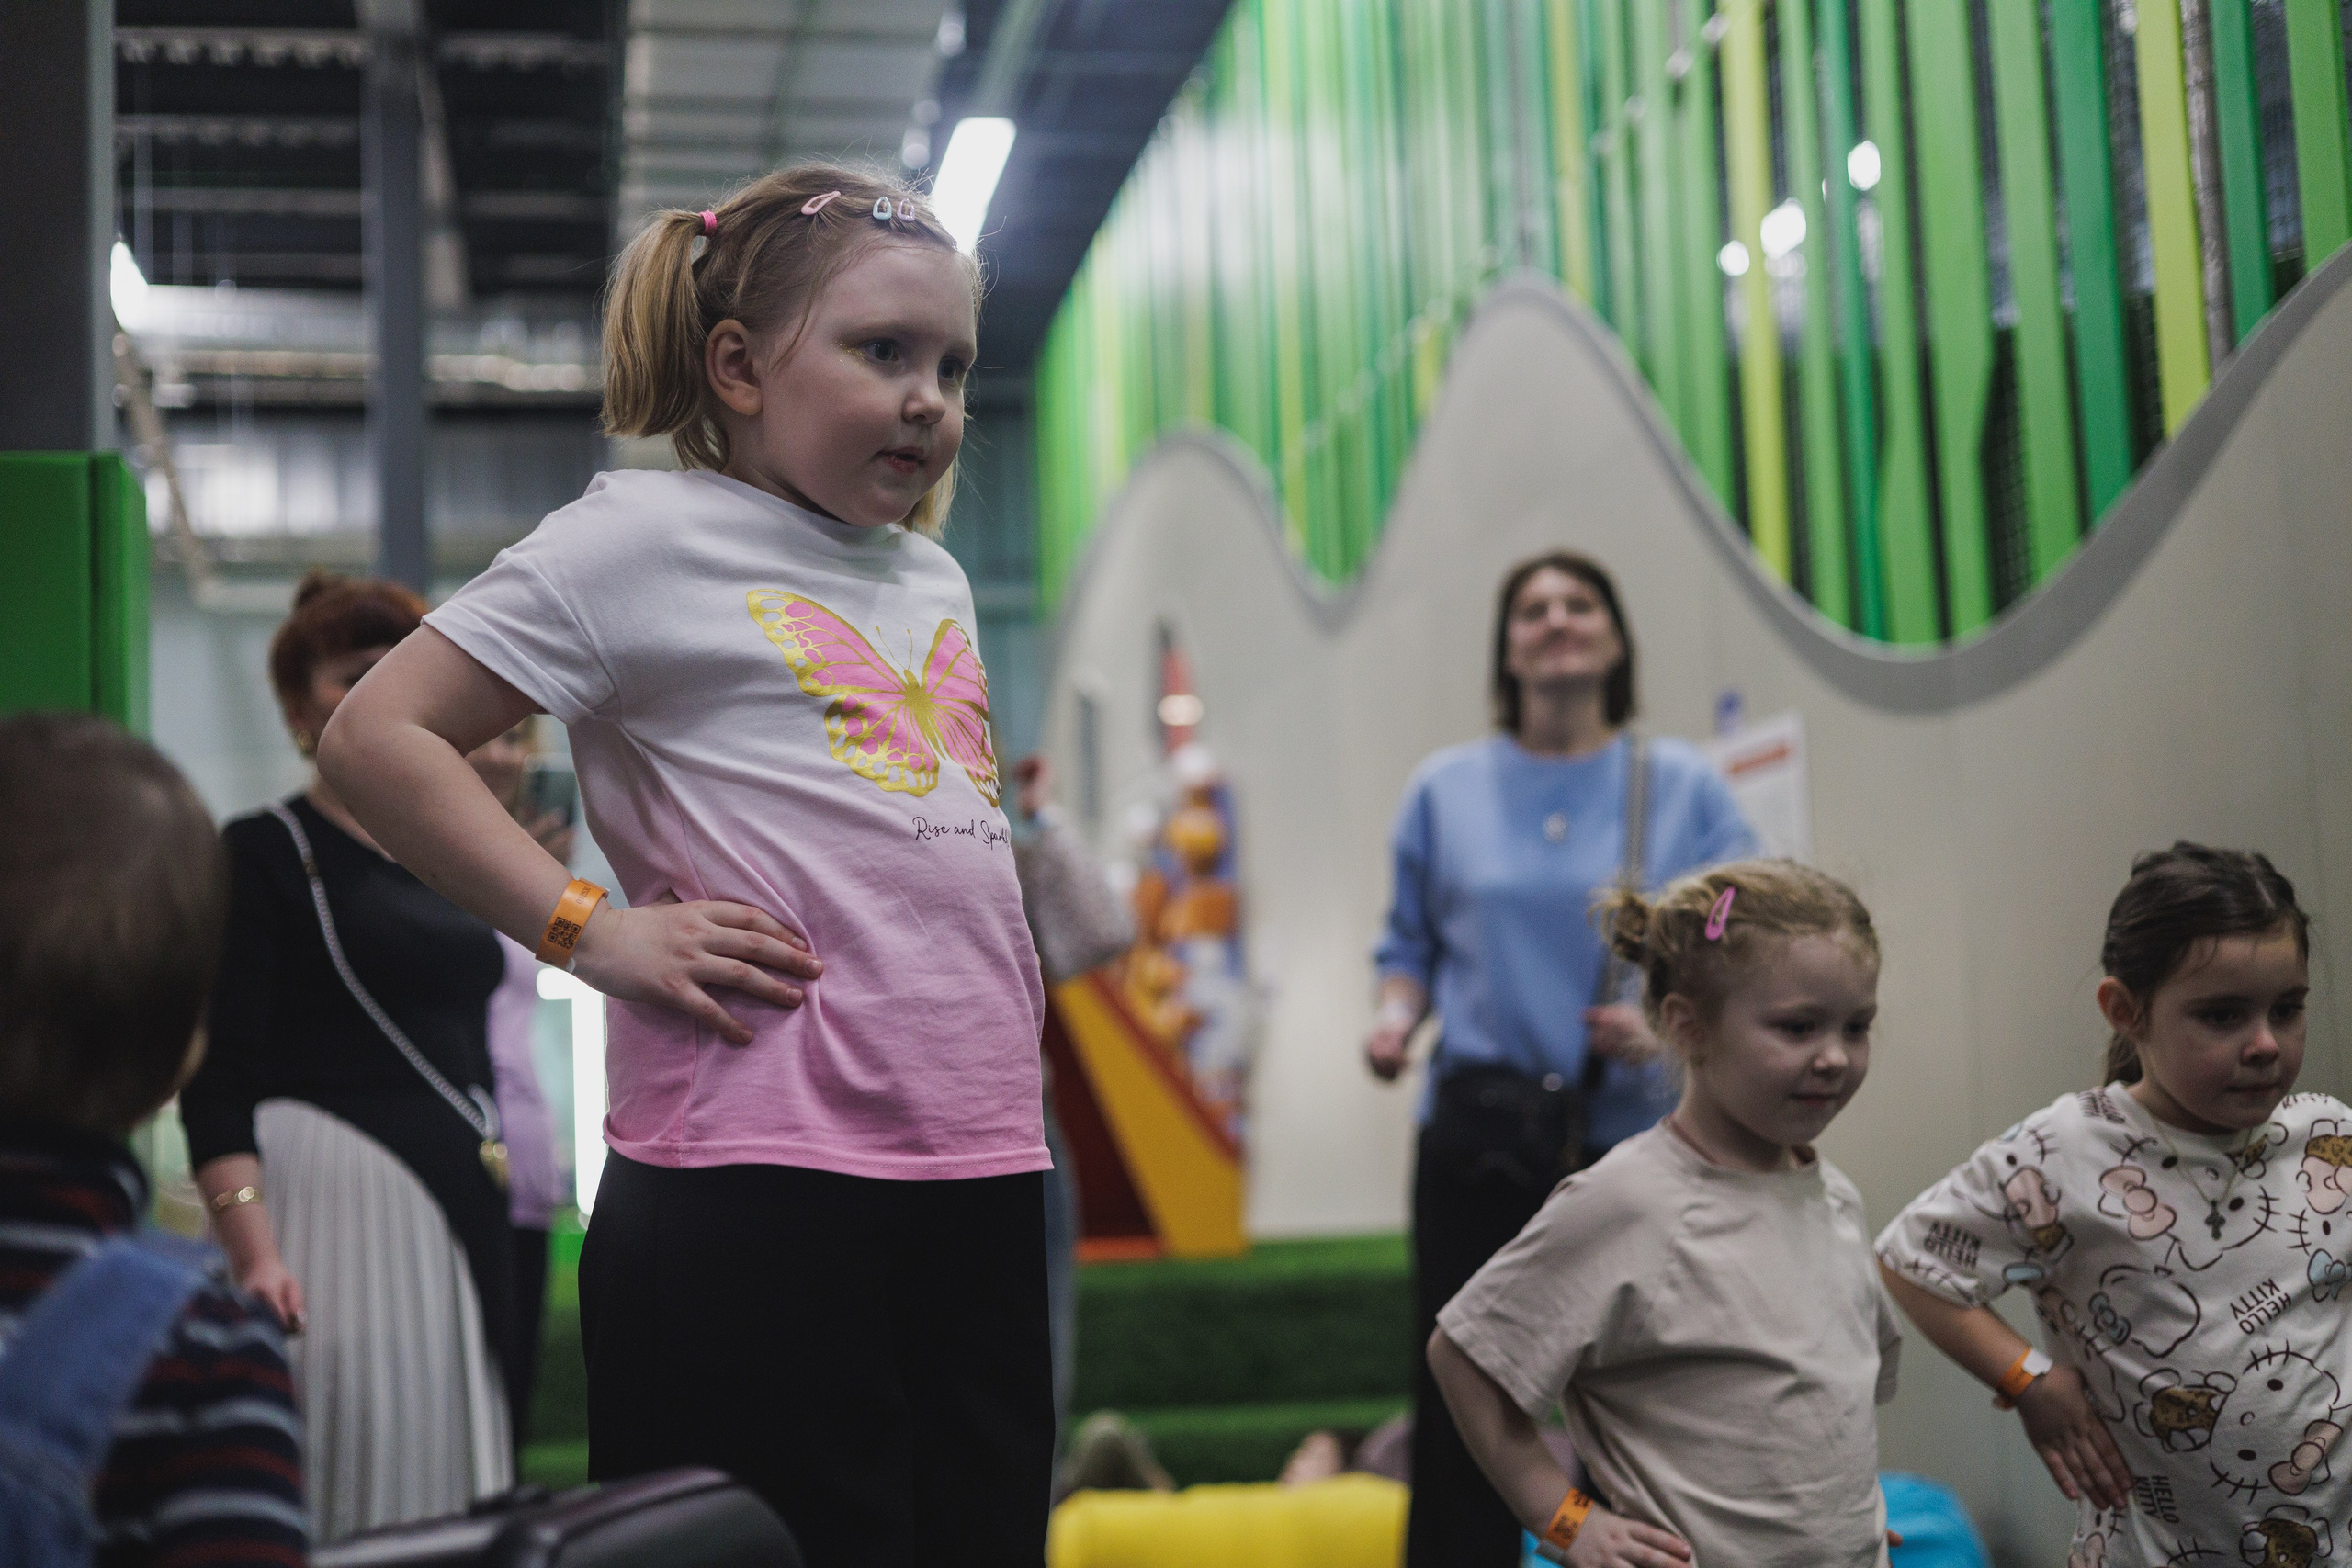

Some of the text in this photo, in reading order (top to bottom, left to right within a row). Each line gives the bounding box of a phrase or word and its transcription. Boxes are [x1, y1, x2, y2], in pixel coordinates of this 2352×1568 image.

[912, 816, 950, 840] Rise
[954, 819, 976, 838] and
[2230, 1278, 2280, 1320] KITTY
[2239, 1293, 2291, 1335] HELLO
[2151, 1475, 2179, 1523] HELLO
